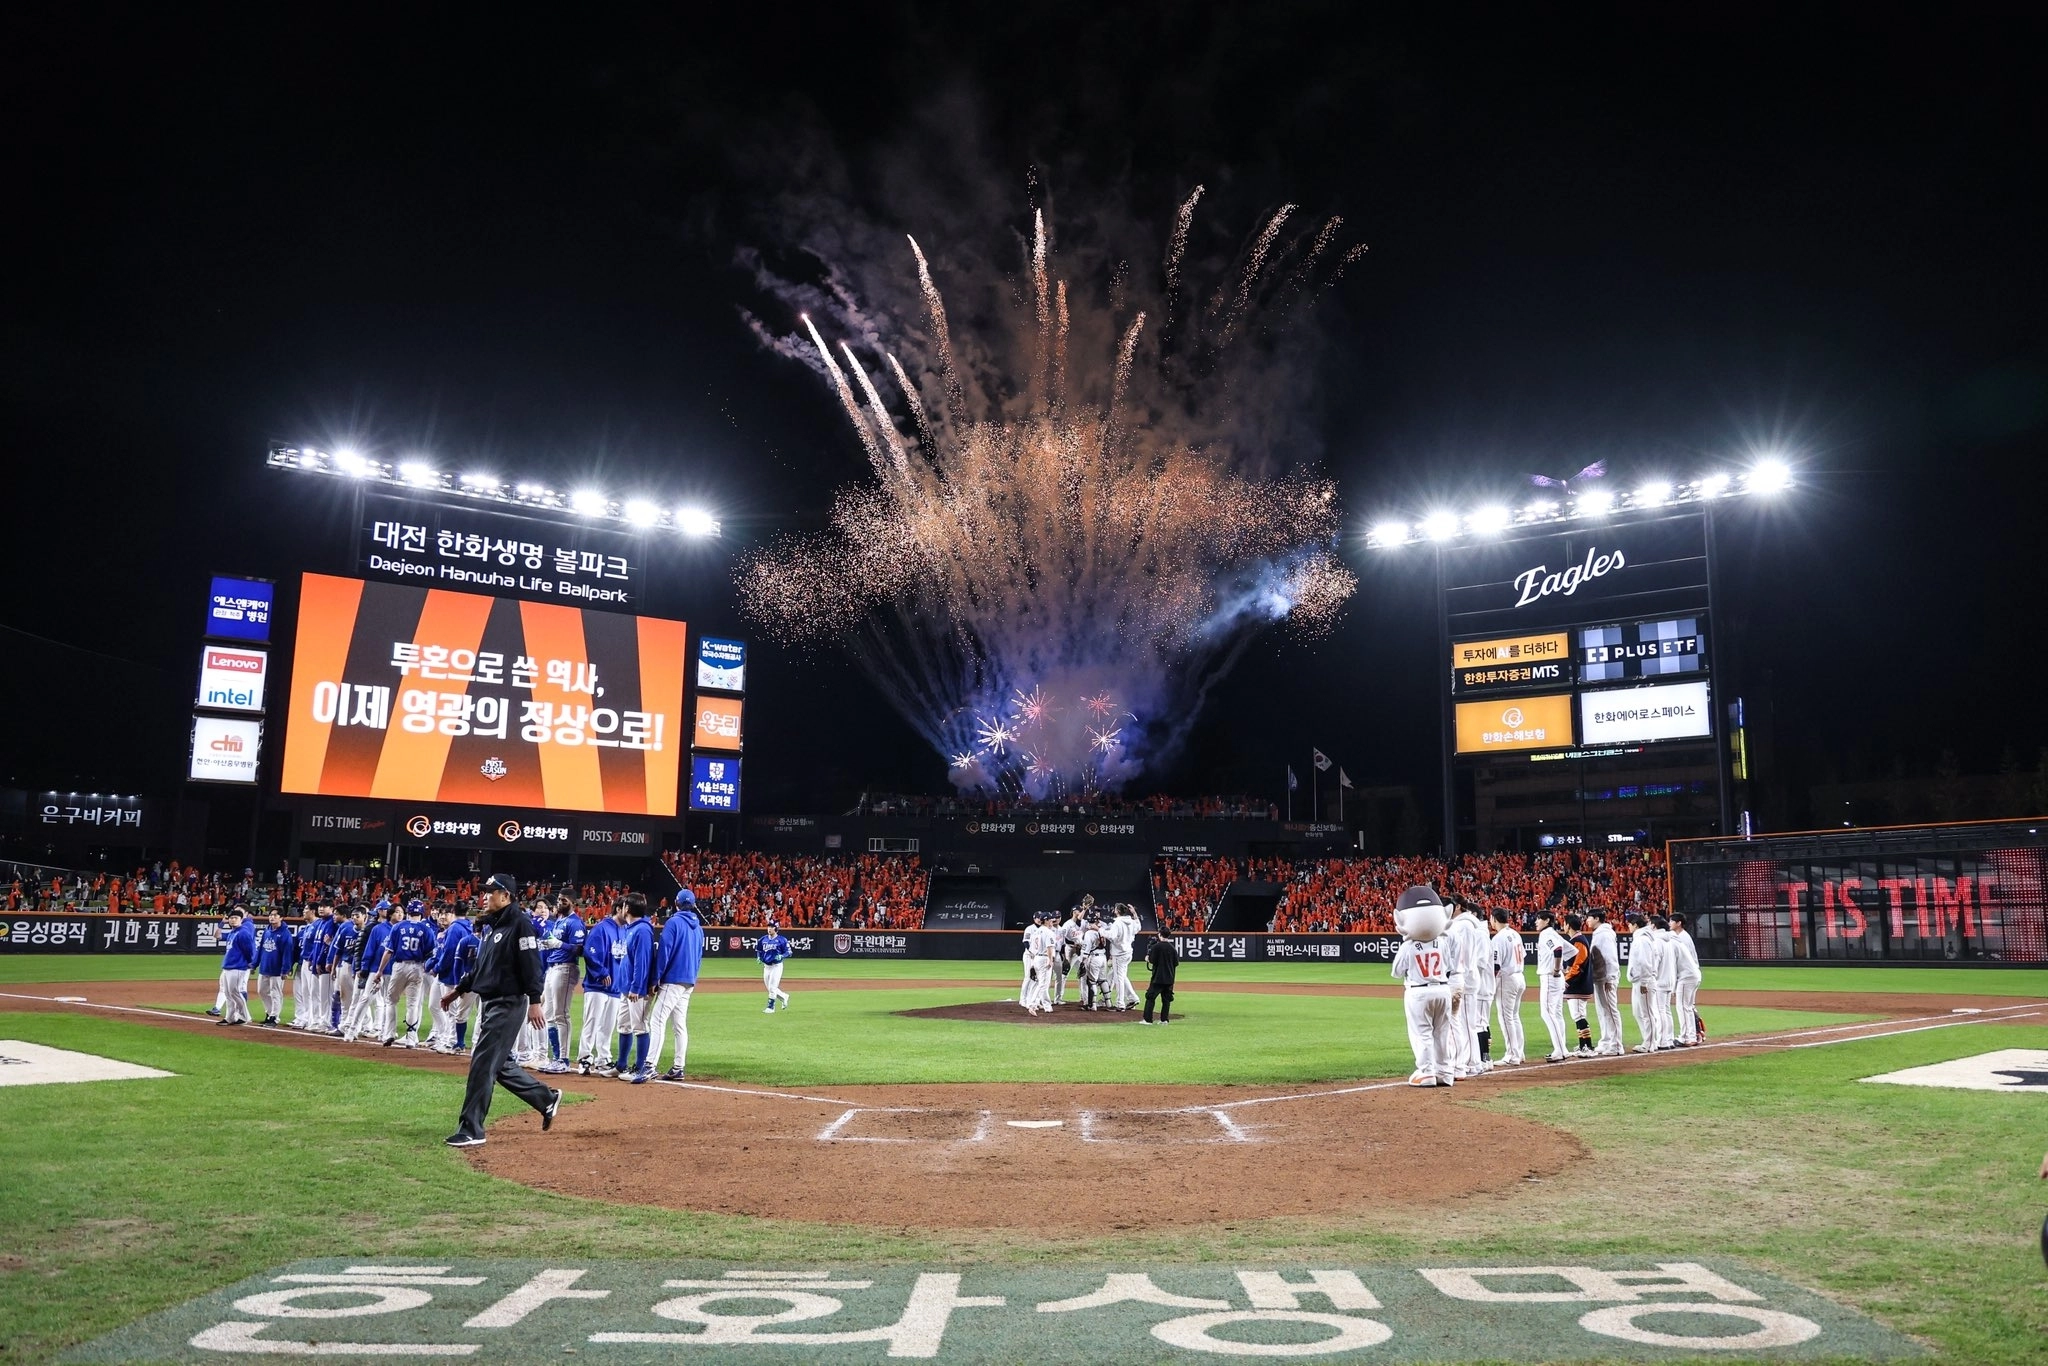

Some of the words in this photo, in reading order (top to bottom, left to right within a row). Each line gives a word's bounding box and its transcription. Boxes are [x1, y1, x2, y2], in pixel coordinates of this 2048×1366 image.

[373, 521, 427, 553] 대전
[436, 530, 543, 570] 한화생명
[553, 547, 629, 580] 볼파크
[370, 555, 435, 576] Daejeon
[441, 565, 515, 587] Hanwha
[520, 575, 553, 592] Life
[558, 581, 628, 603] Ballpark
[1513, 546, 1626, 608] Eagles
[246, 610, 268, 623] 병원
[702, 640, 743, 654] K-water
[1523, 640, 1559, 656] 더하다
[1614, 643, 1657, 659] PLUS
[1662, 639, 1696, 654] ETF
[211, 655, 259, 669] Lenovo
[702, 650, 742, 661] 한국수자원공사
[390, 642, 504, 685] 투혼으로
[511, 655, 539, 688] 쓴
[546, 659, 605, 699] 역사,
[208, 688, 253, 706] intel
[312, 681, 391, 730] 이제
[402, 689, 509, 740] 영광의
[519, 700, 665, 751] 정상으로!
[1594, 705, 1695, 724] 한화에어로스페이스
[1482, 729, 1545, 744] 한화손해보험
[480, 765, 507, 774] SEASON
[485, 759, 503, 767] POST
[699, 794, 731, 807] 치과의원
[40, 805, 142, 828] 은구비커피
[311, 815, 323, 827] IT
[324, 815, 334, 828] IS
[336, 816, 361, 829] TIME
[433, 820, 481, 836] 한화생명
[523, 826, 569, 840] 한화생명
[980, 822, 1016, 833] 한화생명
[1040, 823, 1075, 834] 한화생명
[1099, 823, 1135, 834] 한화생명
[1824, 878, 1867, 939] IS
[1877, 875, 2002, 939] TIME
[12, 921, 87, 944] 음성명작
[401, 936, 420, 951] 30
[853, 935, 907, 948] 목원대학교
[1266, 944, 1320, 957] 챔피언스시티
[1322, 945, 1340, 957] 광주
[1415, 952, 1441, 978] V2
[190, 1262, 1823, 1359] 한화생명
